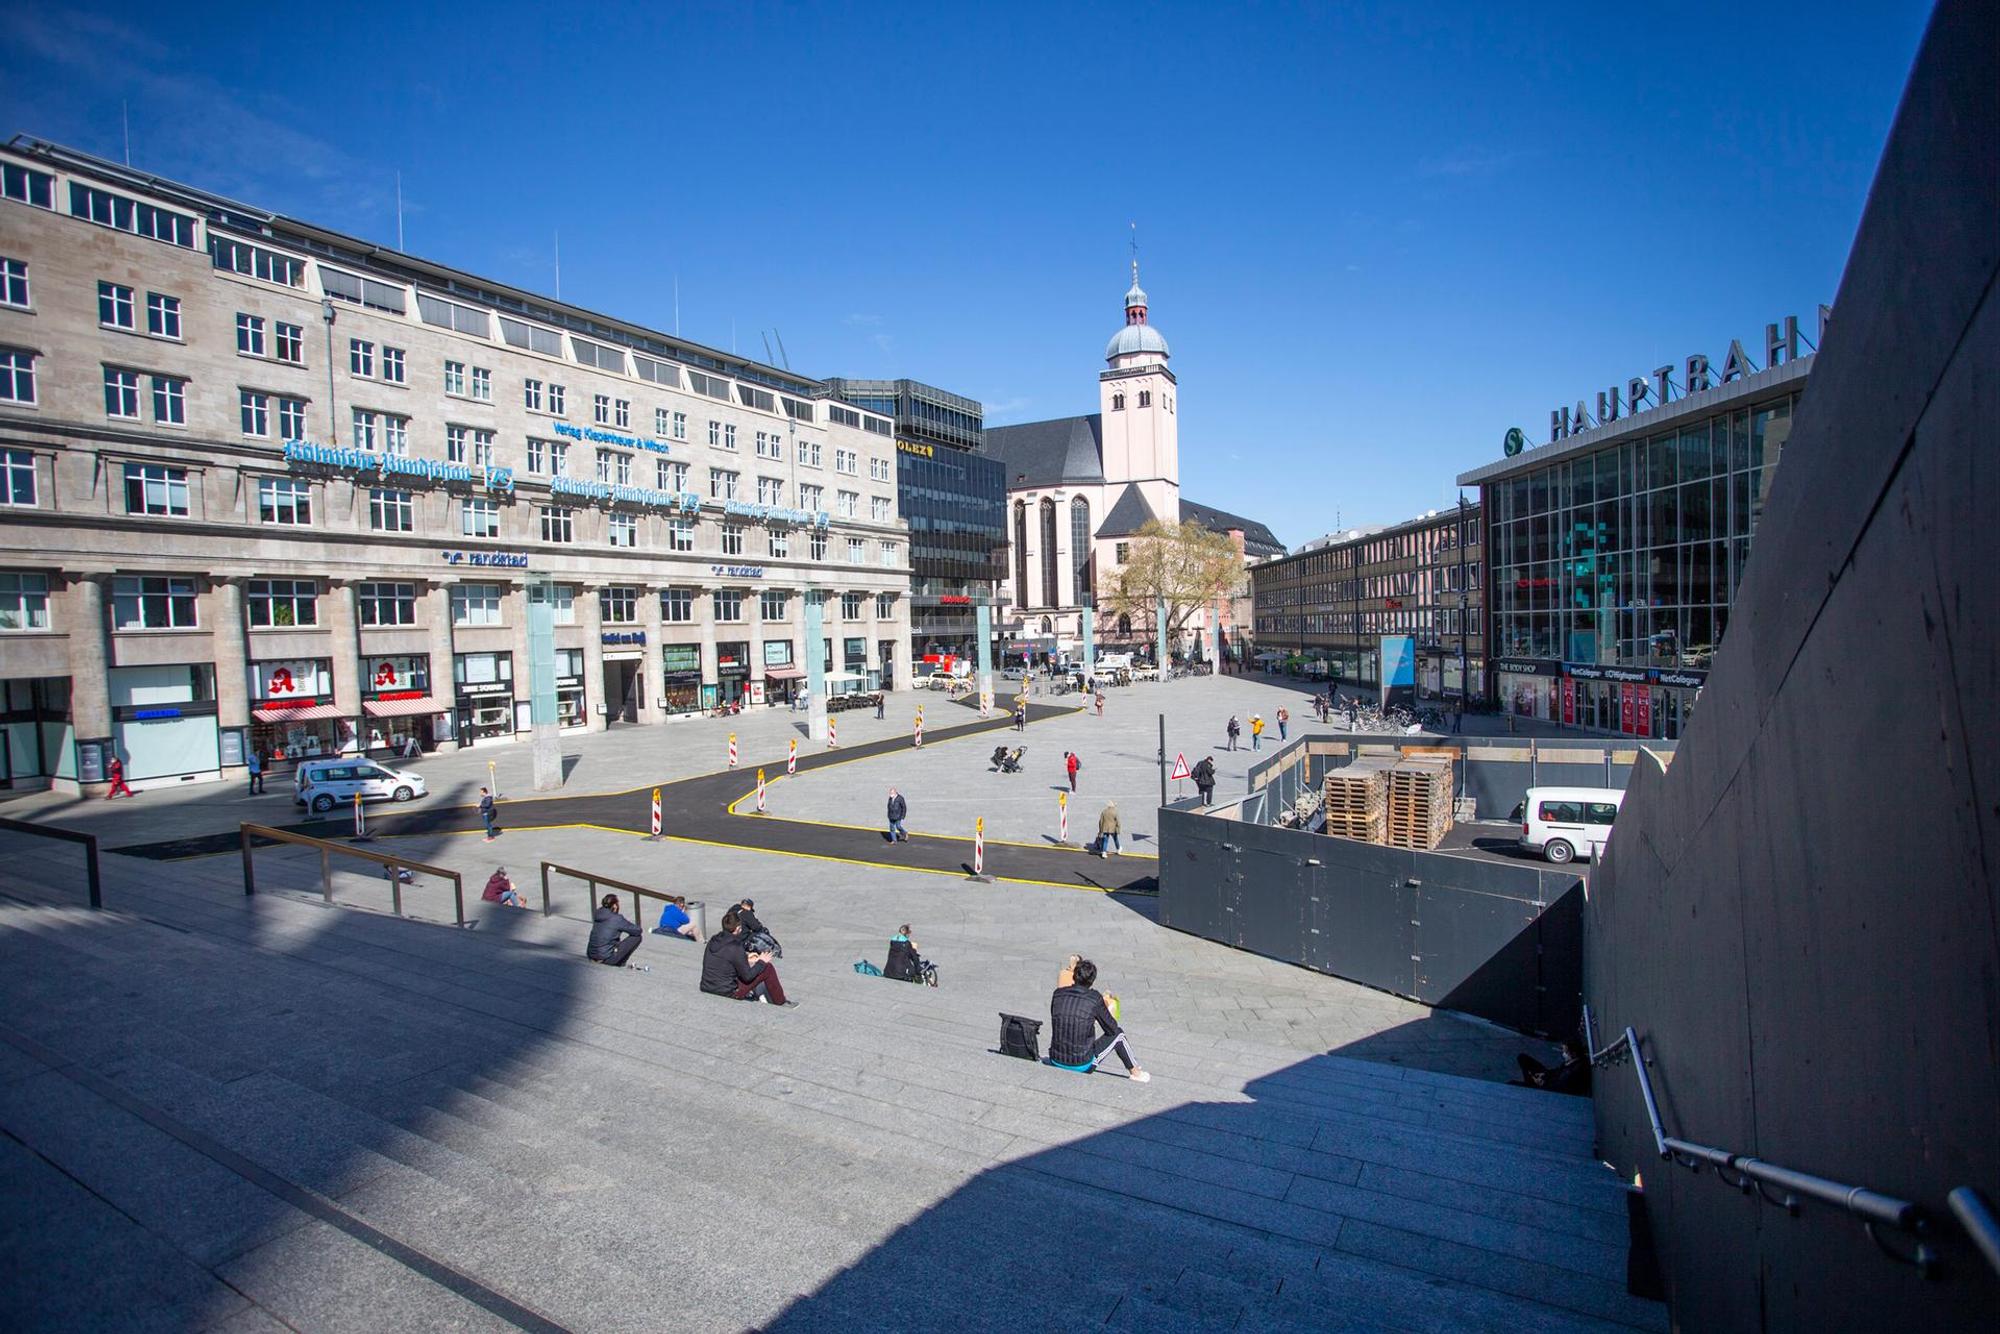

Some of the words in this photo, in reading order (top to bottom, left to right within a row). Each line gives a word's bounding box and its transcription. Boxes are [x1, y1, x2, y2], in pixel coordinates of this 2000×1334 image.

[553, 422, 582, 441] Verlag
[380, 452, 472, 481] Rundschau
[468, 551, 528, 568] randstad
[727, 565, 763, 578] randstad
[1523, 664, 1537, 673] SHOP
[1571, 667, 1601, 678] NetCologne
[1660, 673, 1702, 686] NetCologne
